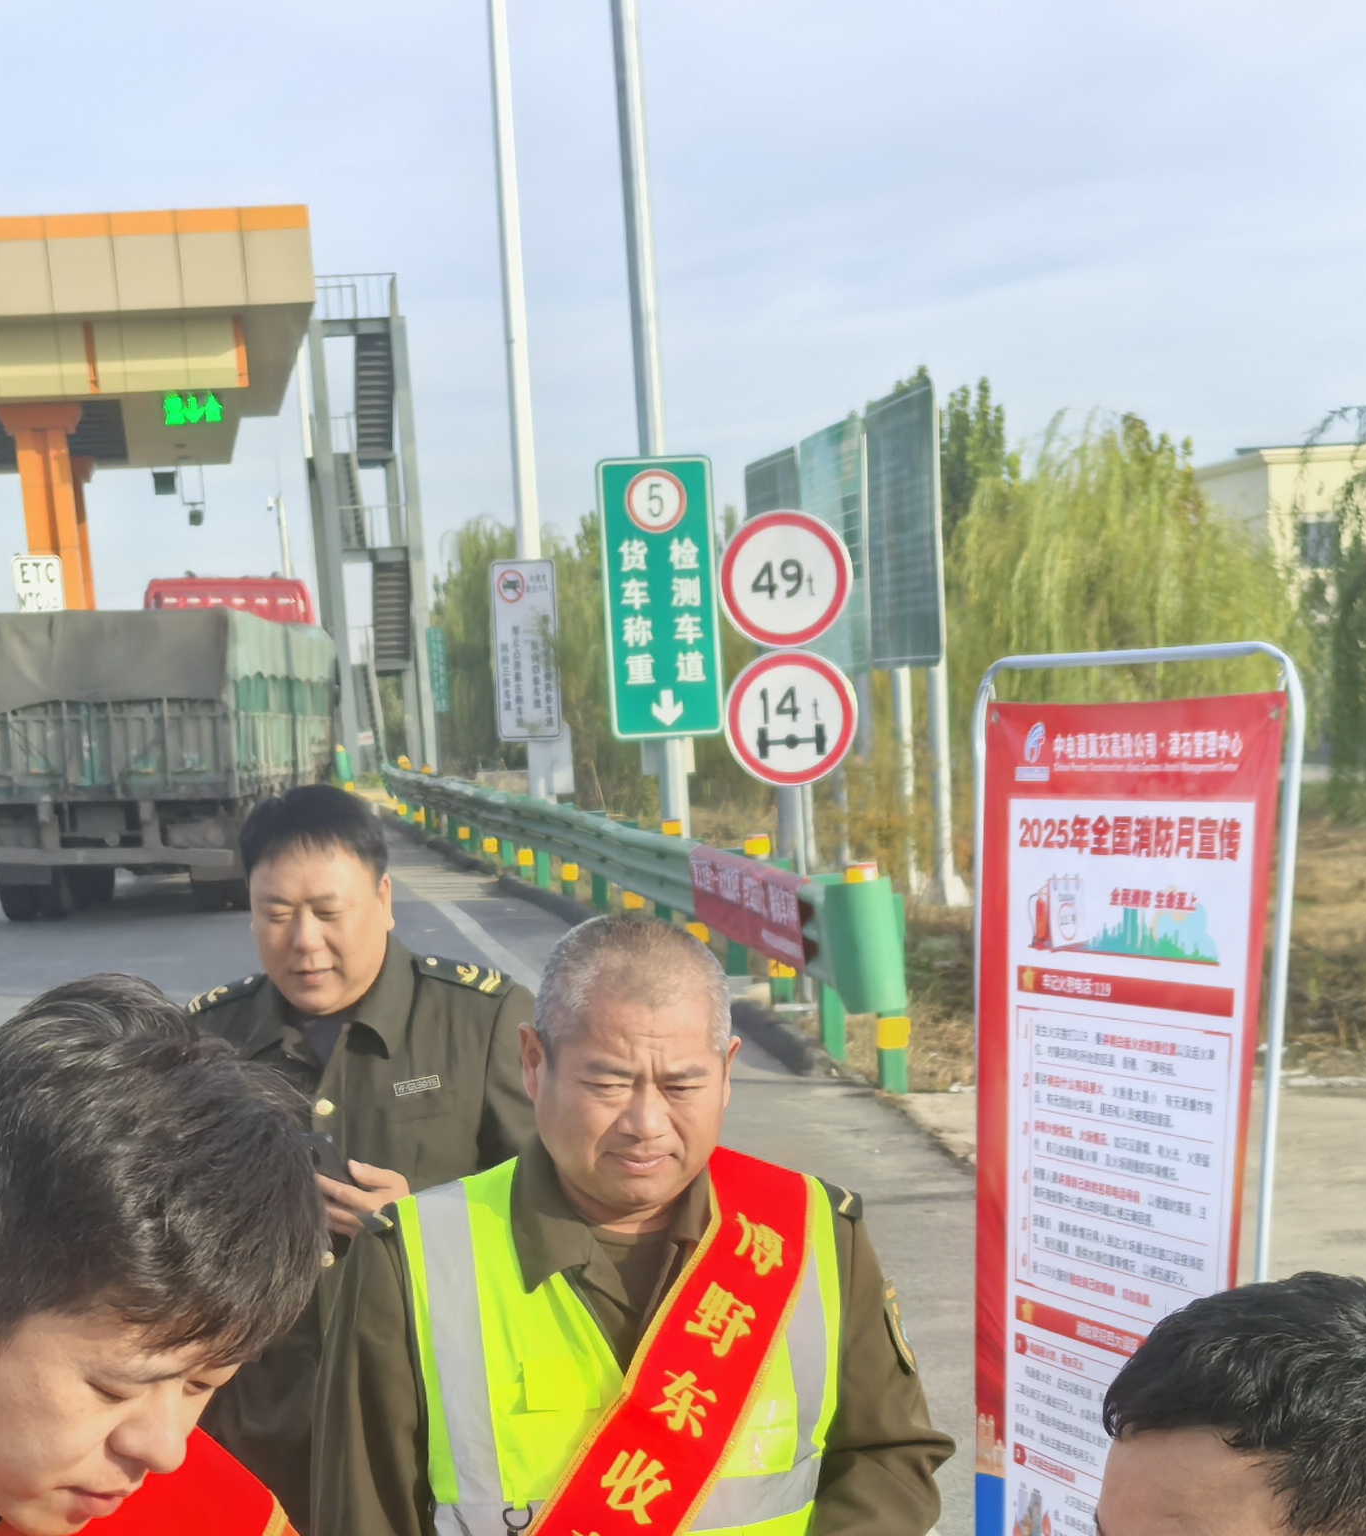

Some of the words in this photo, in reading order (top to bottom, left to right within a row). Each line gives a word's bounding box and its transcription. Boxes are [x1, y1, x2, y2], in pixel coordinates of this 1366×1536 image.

[646, 482, 665, 519] 5
[20, 562, 55, 583] ETC
[617, 537, 655, 686] 货车称重
[669, 536, 707, 683] 检测车道
[1018, 813, 1243, 862] 2025年全国消防月宣传
